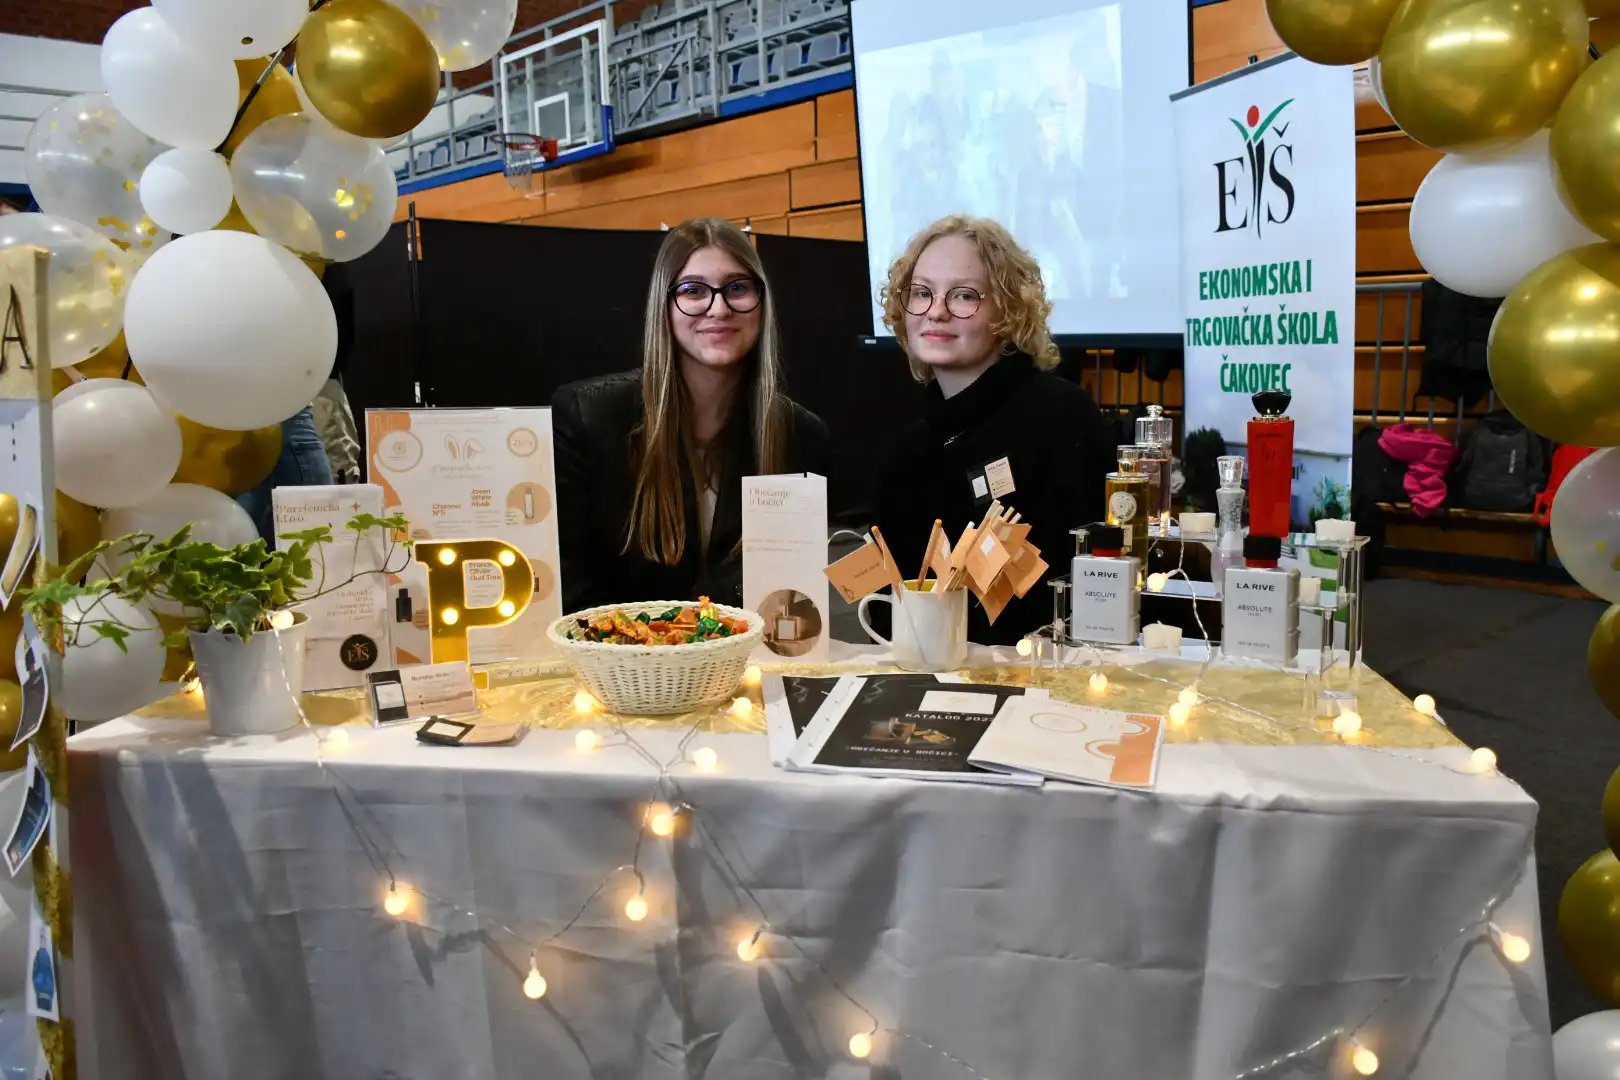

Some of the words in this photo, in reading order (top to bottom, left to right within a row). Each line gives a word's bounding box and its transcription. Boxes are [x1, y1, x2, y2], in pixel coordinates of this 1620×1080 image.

[1199, 260, 1302, 300] EKONOMSKA
[1306, 259, 1312, 292] I
[1186, 305, 1274, 346] TRGOVAČKA
[1277, 303, 1339, 345] ŠKOLA
[1220, 353, 1291, 395] ČAKOVEC
[1097, 571, 1119, 579] RIVE
[1251, 583, 1276, 592] RIVE
[1084, 591, 1117, 599] ABSOLUTE
[413, 538, 536, 664] P
[1237, 604, 1273, 613] ABSOLUTE
[904, 712, 961, 721] KATALOG
